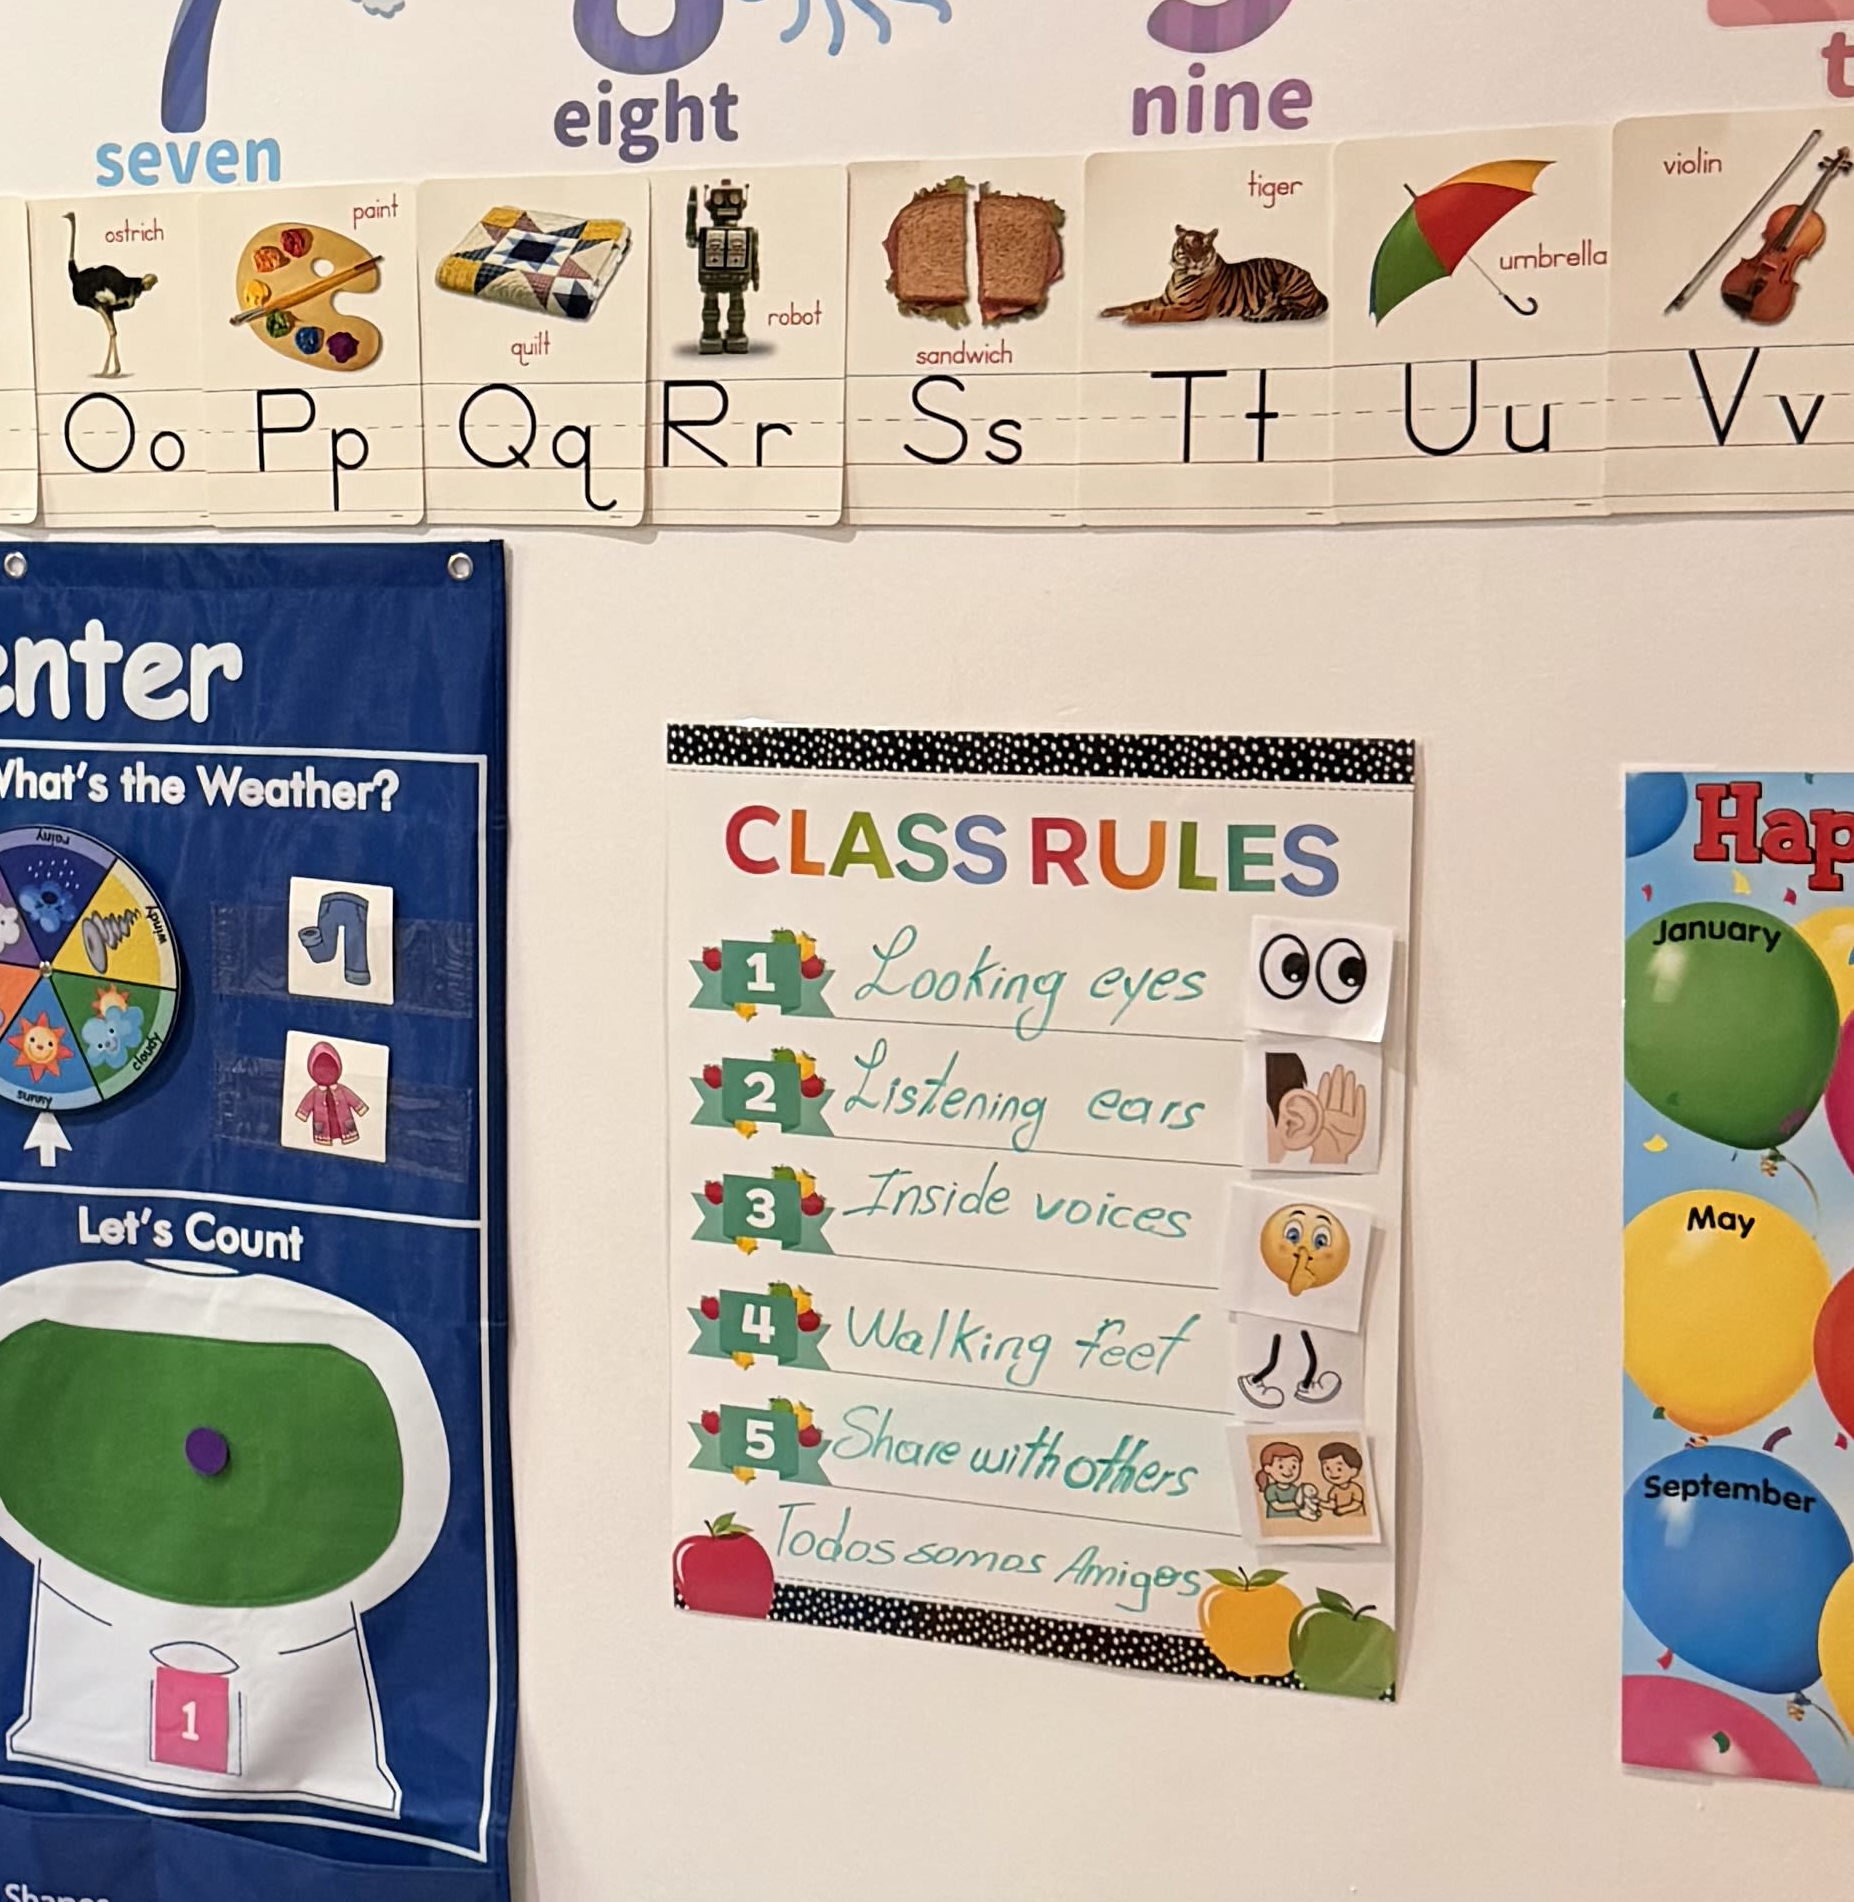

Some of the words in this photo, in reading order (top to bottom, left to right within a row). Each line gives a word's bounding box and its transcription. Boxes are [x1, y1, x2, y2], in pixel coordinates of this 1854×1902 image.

[553, 78, 740, 163] eight
[1131, 62, 1313, 136] nine
[95, 137, 282, 189] seven
[1664, 150, 1723, 176] violin
[352, 197, 398, 229] paint
[1247, 172, 1303, 209] tiger
[105, 220, 165, 244] ostrich
[1499, 241, 1608, 271] umbrella
[768, 302, 823, 327] robot
[510, 332, 550, 366] quilt
[916, 341, 1013, 366] sandwich
[1151, 368, 1278, 463] Tt
[1689, 347, 1824, 446] Vv
[64, 391, 185, 474] Oo
[662, 380, 792, 468] Rr
[904, 375, 1022, 465] Ss
[256, 388, 369, 512] Pp
[459, 382, 617, 511] Qq
[120, 761, 186, 805] the
[195, 764, 400, 811] Weather?
[725, 804, 1008, 886] CLASS
[1030, 817, 1341, 898] RULES
[145, 905, 167, 945] windy
[1652, 918, 1781, 953] January
[745, 952, 775, 992] 1
[855, 926, 1064, 1042] Looking
[1089, 966, 1207, 1026] eyes
[132, 1032, 163, 1072] cloudy
[744, 1072, 777, 1112] 2
[844, 1038, 1047, 1152] Listening
[1087, 1088, 1205, 1130] ears
[745, 1188, 776, 1228] 3
[844, 1162, 1010, 1217] Inside
[1035, 1192, 1192, 1239] voices
[1687, 1205, 1755, 1240] May
[79, 1206, 173, 1248] Let's
[185, 1211, 304, 1262] Count
[742, 1303, 775, 1344] 4
[847, 1307, 1052, 1387] Walking
[1076, 1313, 1200, 1377] feet
[745, 1420, 775, 1460] 5
[833, 1406, 960, 1467] Share
[969, 1425, 1062, 1481] with
[1064, 1433, 1199, 1498] others
[1643, 1474, 1816, 1514] September
[775, 1502, 895, 1564] Todos
[904, 1534, 1046, 1575] somos
[1054, 1545, 1204, 1612] Amigos
[181, 1701, 201, 1742] 1
